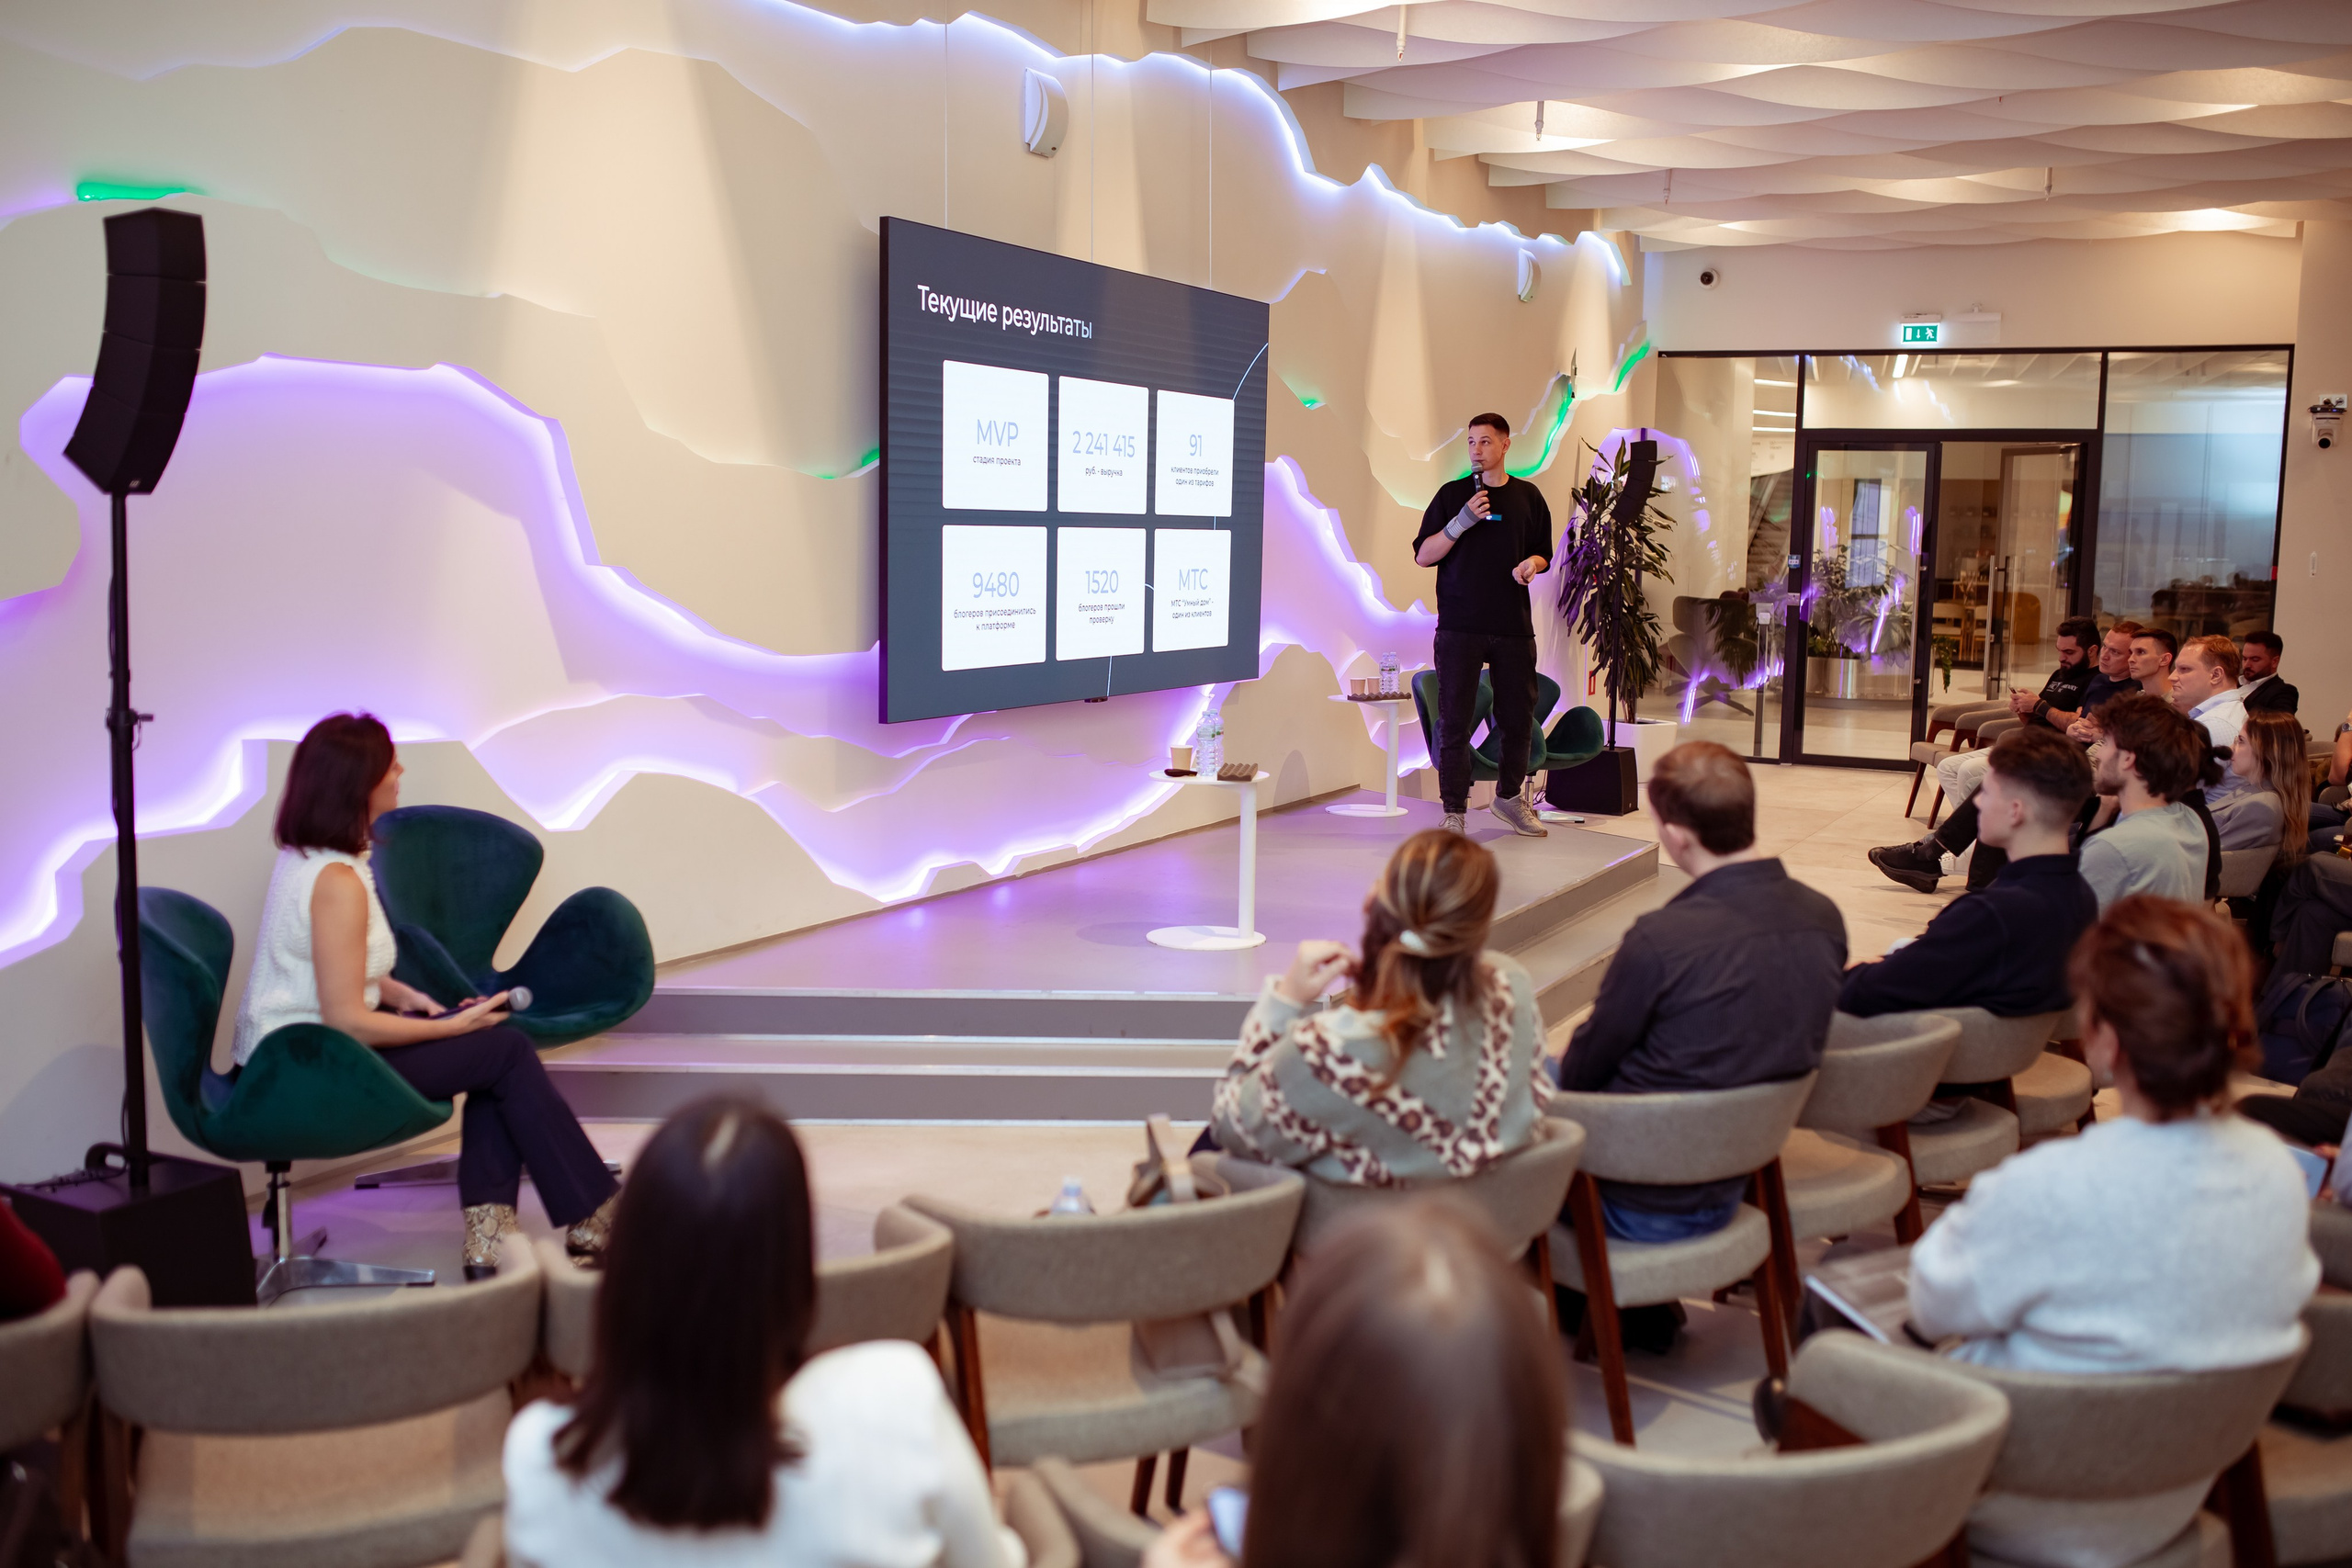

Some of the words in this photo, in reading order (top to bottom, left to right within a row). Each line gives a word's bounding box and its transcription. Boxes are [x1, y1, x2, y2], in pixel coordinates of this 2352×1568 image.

[917, 284, 999, 323] Текущие
[1001, 305, 1092, 339] результаты
[977, 419, 1019, 447] MVP
[1072, 430, 1081, 454] 2
[1085, 432, 1108, 456] 241
[1113, 434, 1136, 458] 415
[1189, 434, 1202, 457] 91
[972, 455, 995, 465] стадия
[996, 457, 1022, 467] проекта
[1085, 466, 1097, 476] руб.
[1101, 468, 1123, 478] выручка
[1193, 467, 1219, 476] приобрели
[1175, 479, 1187, 487] один
[1194, 479, 1214, 488] тарифов
[972, 571, 1019, 598] 9480
[1085, 570, 1119, 594] 1520
[954, 608, 984, 619] блогеров
[985, 607, 1036, 618] присоединились
[1078, 603, 1103, 613] блогеров
[1104, 603, 1125, 612] прошли
[1089, 615, 1114, 625] проверку
[1171, 611, 1184, 619] один
[981, 621, 1016, 631] платформе
